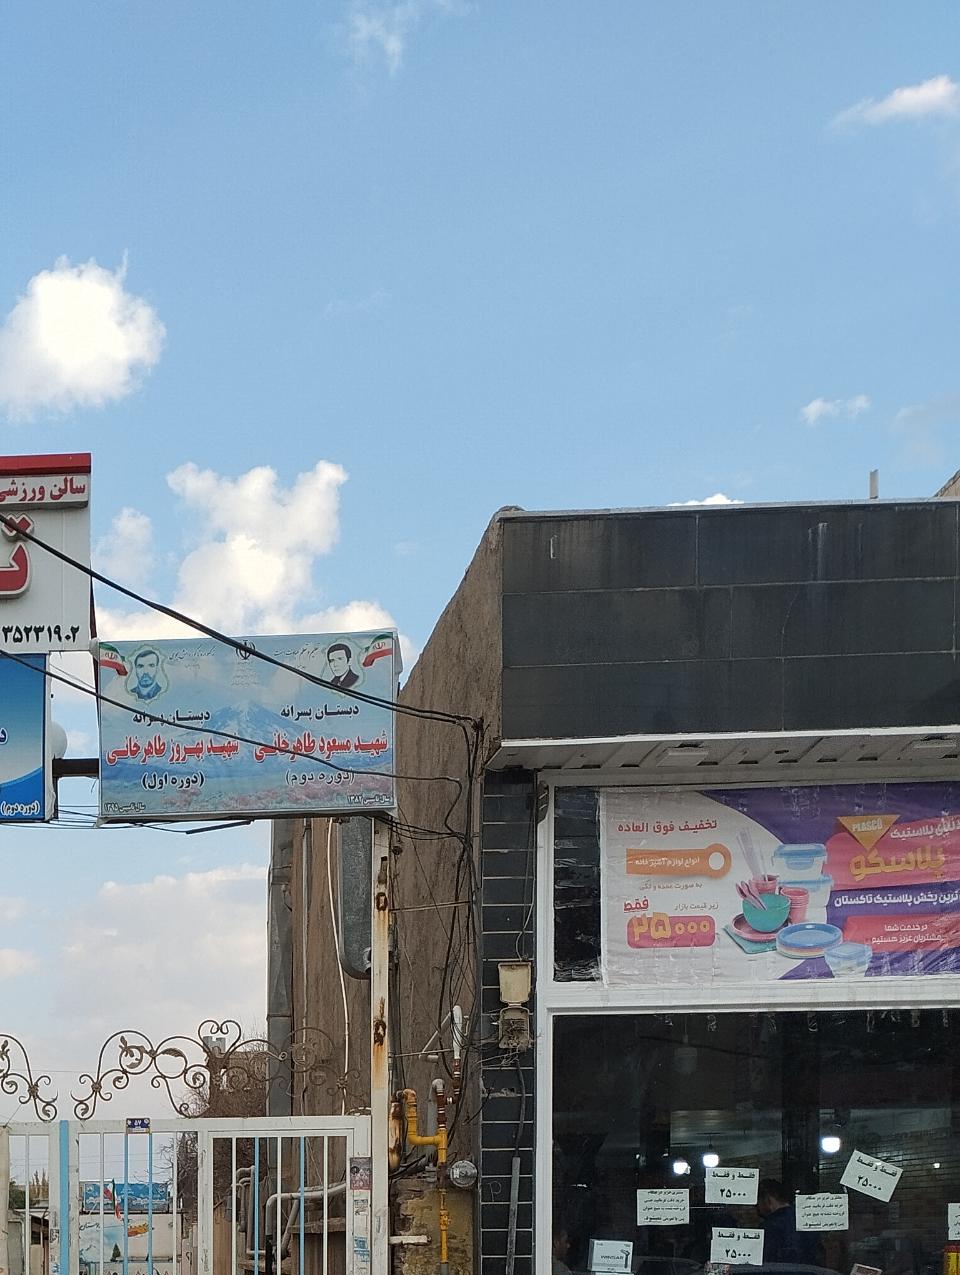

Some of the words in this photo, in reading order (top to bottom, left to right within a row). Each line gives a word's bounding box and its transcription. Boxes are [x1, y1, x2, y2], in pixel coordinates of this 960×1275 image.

[51, 476, 86, 500] سالن
[1, 625, 80, 645] ۳۵۲۳۱۹۰۲
[132, 711, 165, 727] پرانه
[169, 709, 211, 727] دبستان
[280, 704, 313, 722] پسرانه
[315, 704, 360, 721] دبستان
[169, 737, 204, 764] بهروز
[206, 733, 240, 760] شهید
[318, 735, 351, 761] مسعود
[354, 730, 388, 757] شهید
[141, 772, 169, 790] اول)
[171, 771, 205, 789] (دوره
[285, 770, 315, 786] دوم)
[0, 800, 20, 816] دوم)
[20, 800, 40, 816] (دوره
[617, 822, 650, 834] العاده
[652, 820, 676, 835] فوق
[678, 819, 718, 833] تخفیف
[852, 818, 883, 832] PLASCO
[890, 825, 934, 840] پلاستیک
[666, 857, 684, 867] لوازم
[684, 856, 700, 868] انواع
[849, 845, 946, 882] پلاسکو
[674, 883, 695, 891] صورت
[623, 896, 649, 912] فقط
[834, 895, 874, 908] تاکستان
[874, 893, 913, 907] پلاستیک
[913, 891, 938, 906] پخش
[674, 903, 689, 911] بازار
[689, 902, 707, 911] قیمت
[708, 902, 719, 911] زیر
[884, 923, 900, 932] شما
[900, 924, 921, 932] خدمت
[871, 935, 899, 945] هستیم
[712, 1170, 730, 1178] فقط
[737, 1171, 756, 1179] فقط
[856, 1175, 882, 1191] ۲۵۰۰۰
[719, 1187, 747, 1198] ۲۵۰۰۰
[717, 1231, 735, 1239] فقط
[742, 1231, 761, 1240] فقط
[725, 1248, 751, 1259] ۲۵۰۰۰
